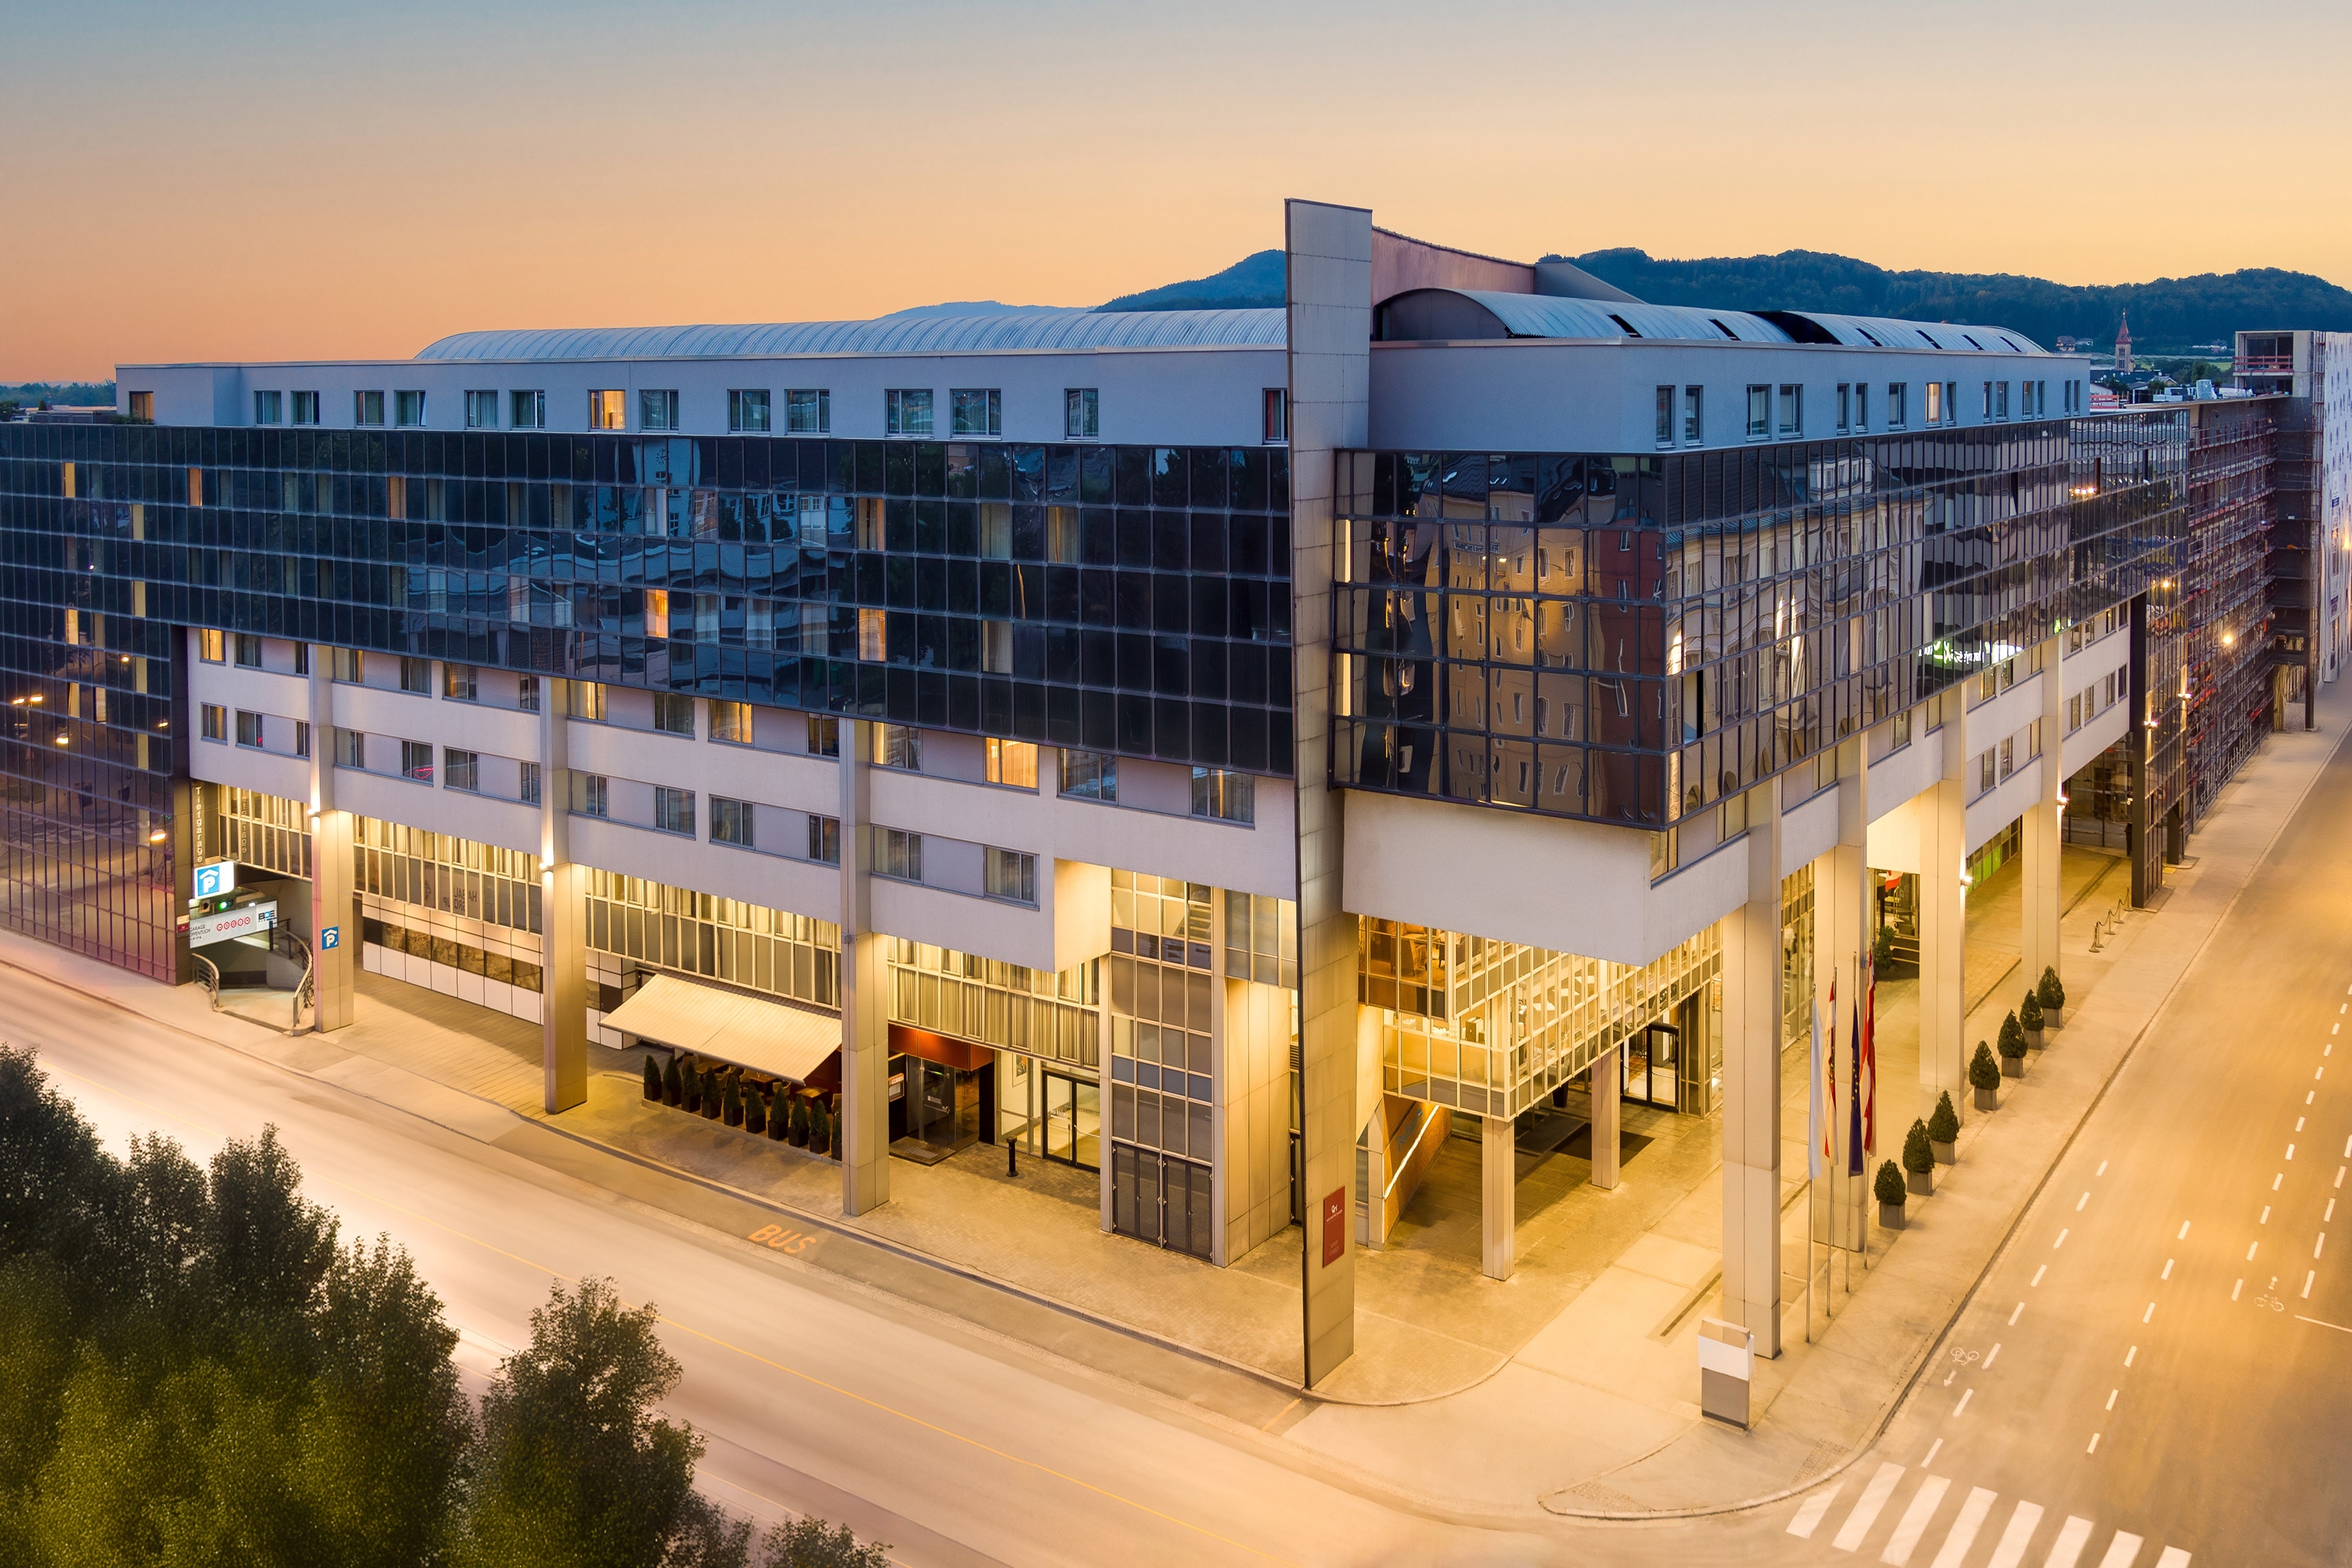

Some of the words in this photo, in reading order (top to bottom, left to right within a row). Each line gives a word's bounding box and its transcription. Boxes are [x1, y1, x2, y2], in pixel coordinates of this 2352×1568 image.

[203, 876, 216, 892] P
[326, 934, 336, 947] P
[747, 1224, 817, 1254] BUS
